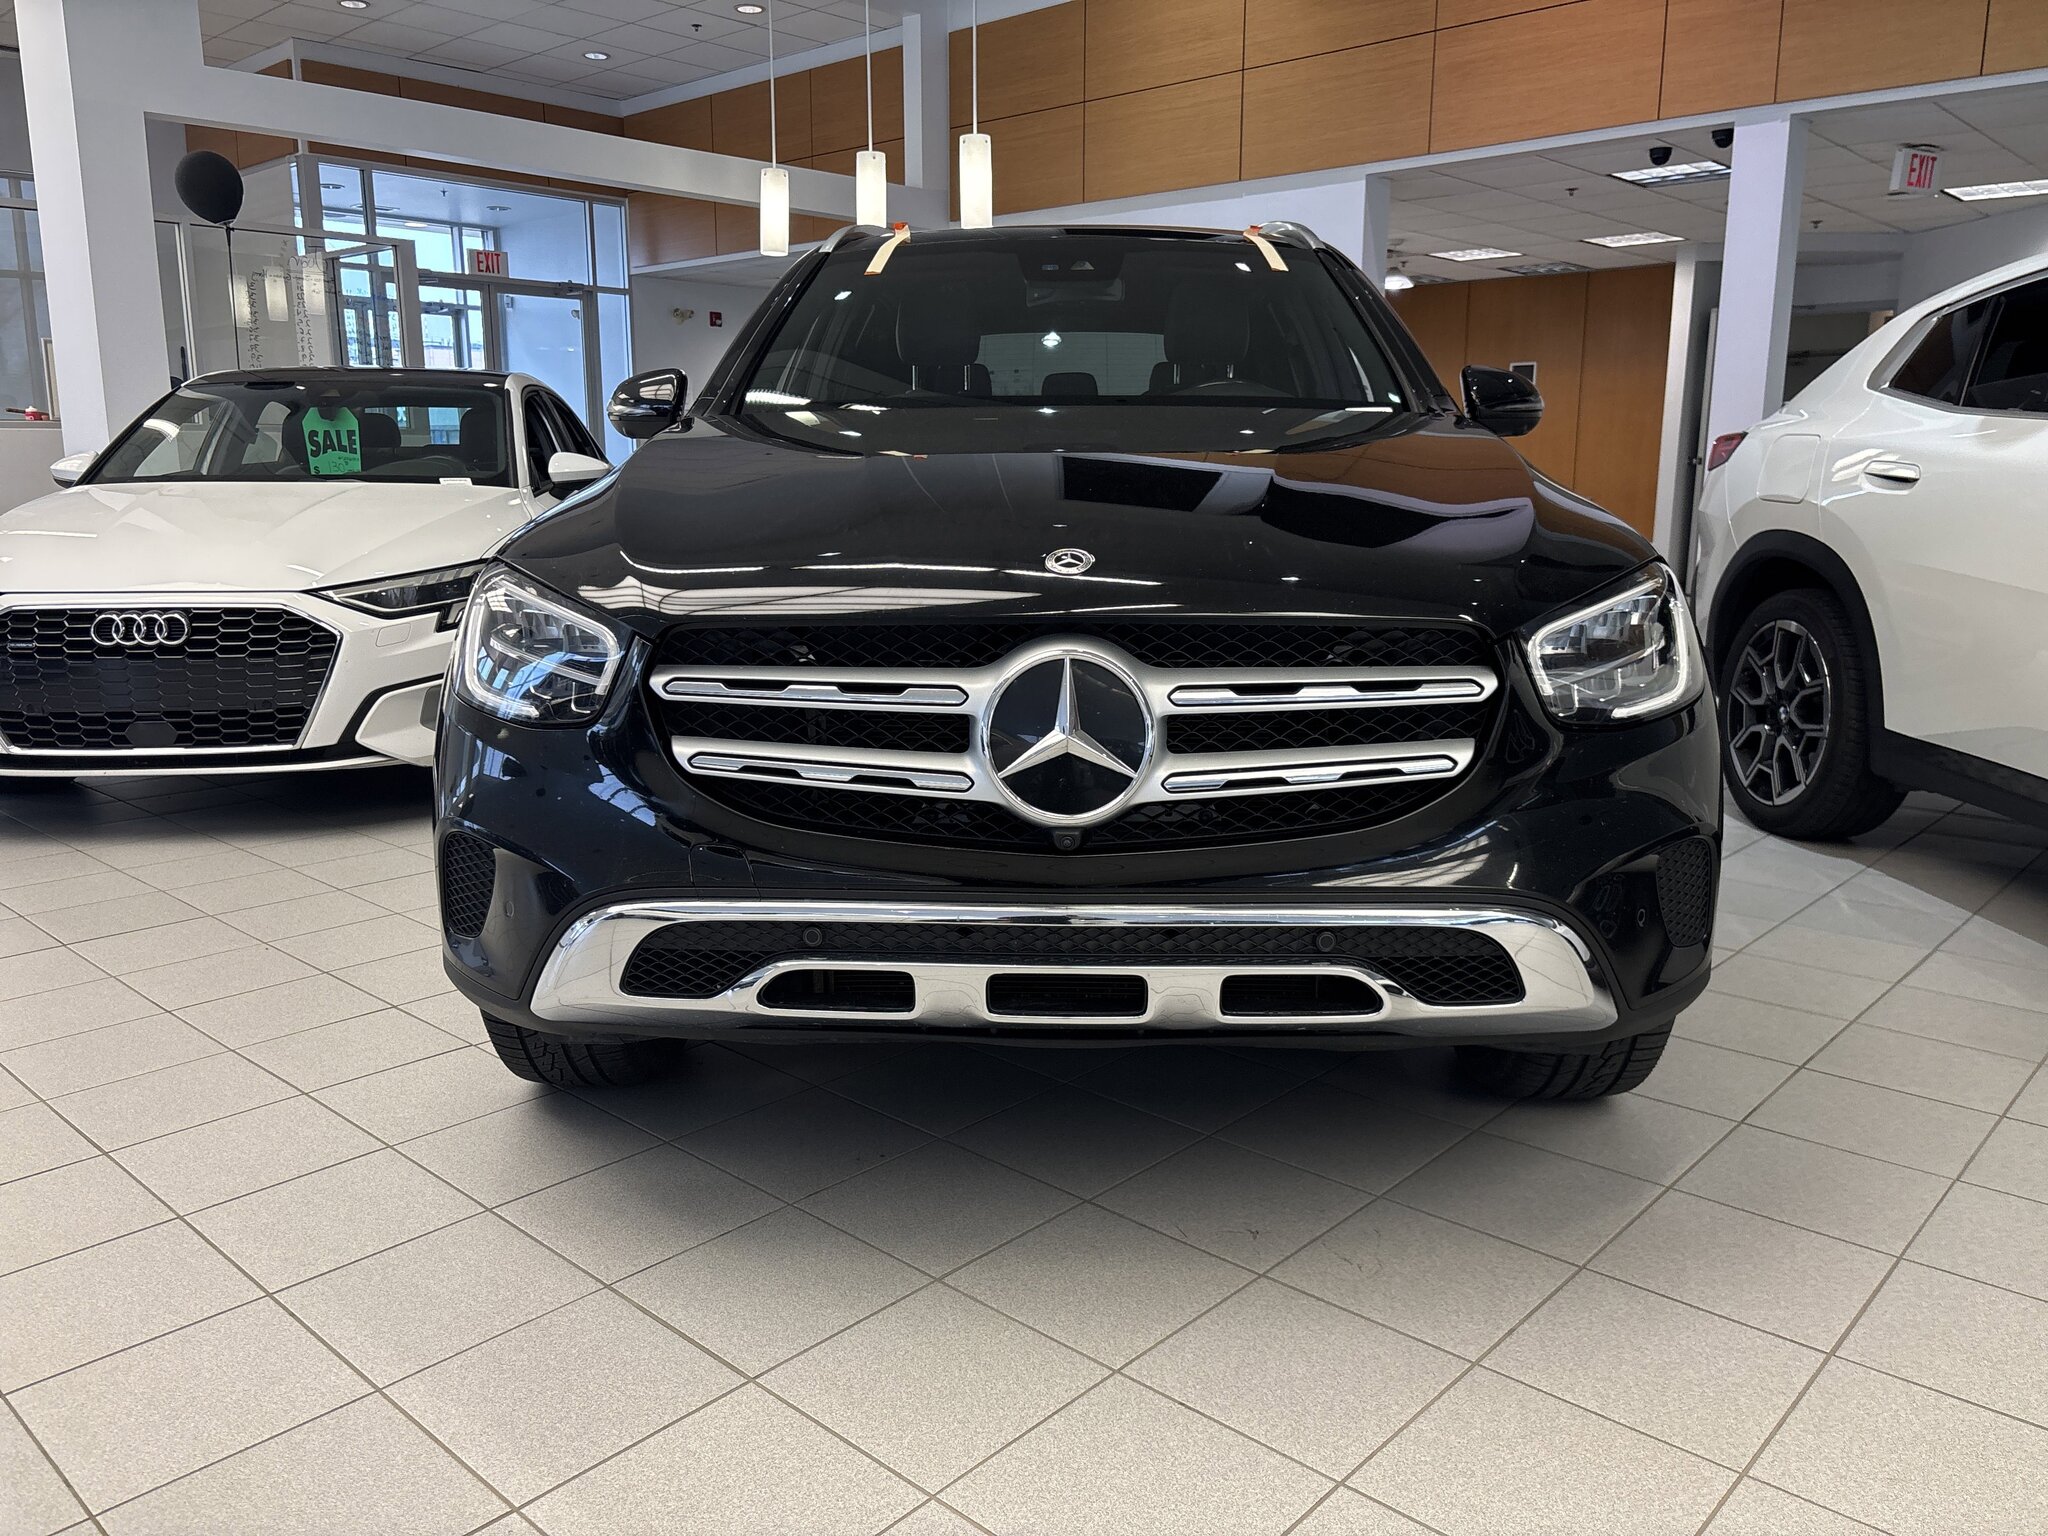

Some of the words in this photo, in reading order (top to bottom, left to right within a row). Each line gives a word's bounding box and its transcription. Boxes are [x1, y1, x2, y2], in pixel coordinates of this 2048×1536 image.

[1907, 153, 1937, 189] EXIT
[476, 251, 501, 274] EXIT
[308, 429, 357, 458] SALE
